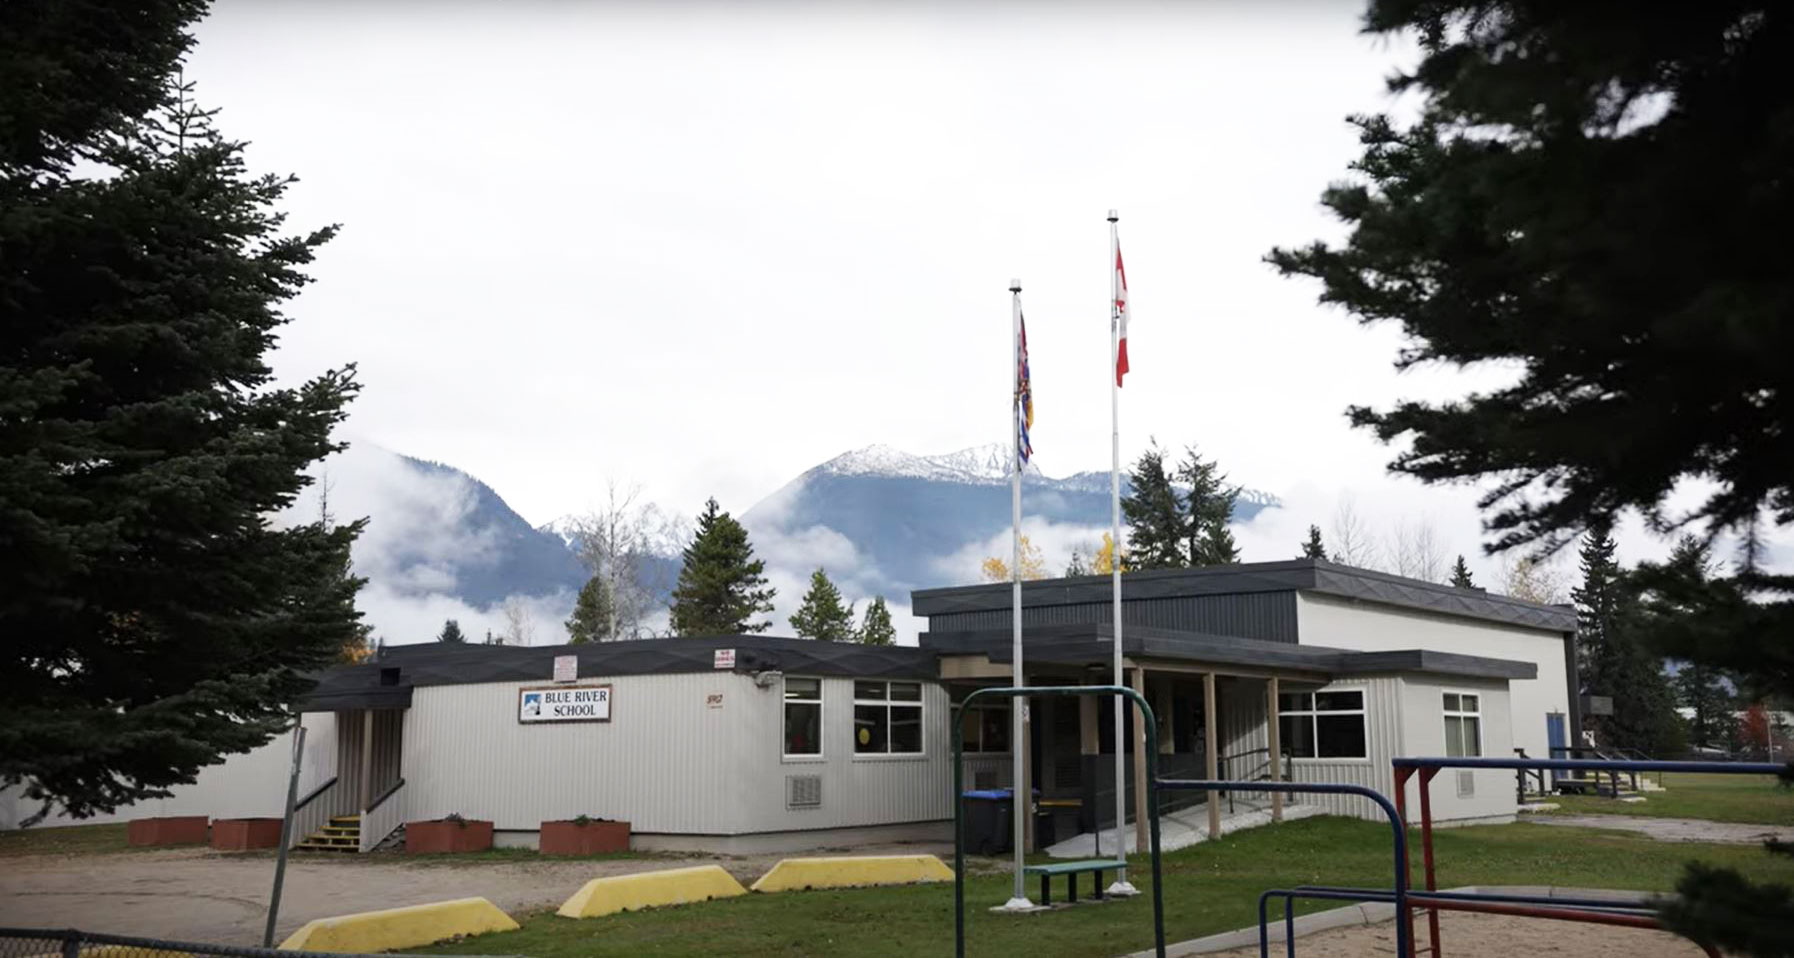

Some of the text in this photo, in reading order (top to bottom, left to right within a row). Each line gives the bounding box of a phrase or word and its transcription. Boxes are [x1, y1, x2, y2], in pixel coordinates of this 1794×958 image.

[545, 691, 607, 703] BLUE RIVER
[554, 705, 596, 716] SCHOOL
